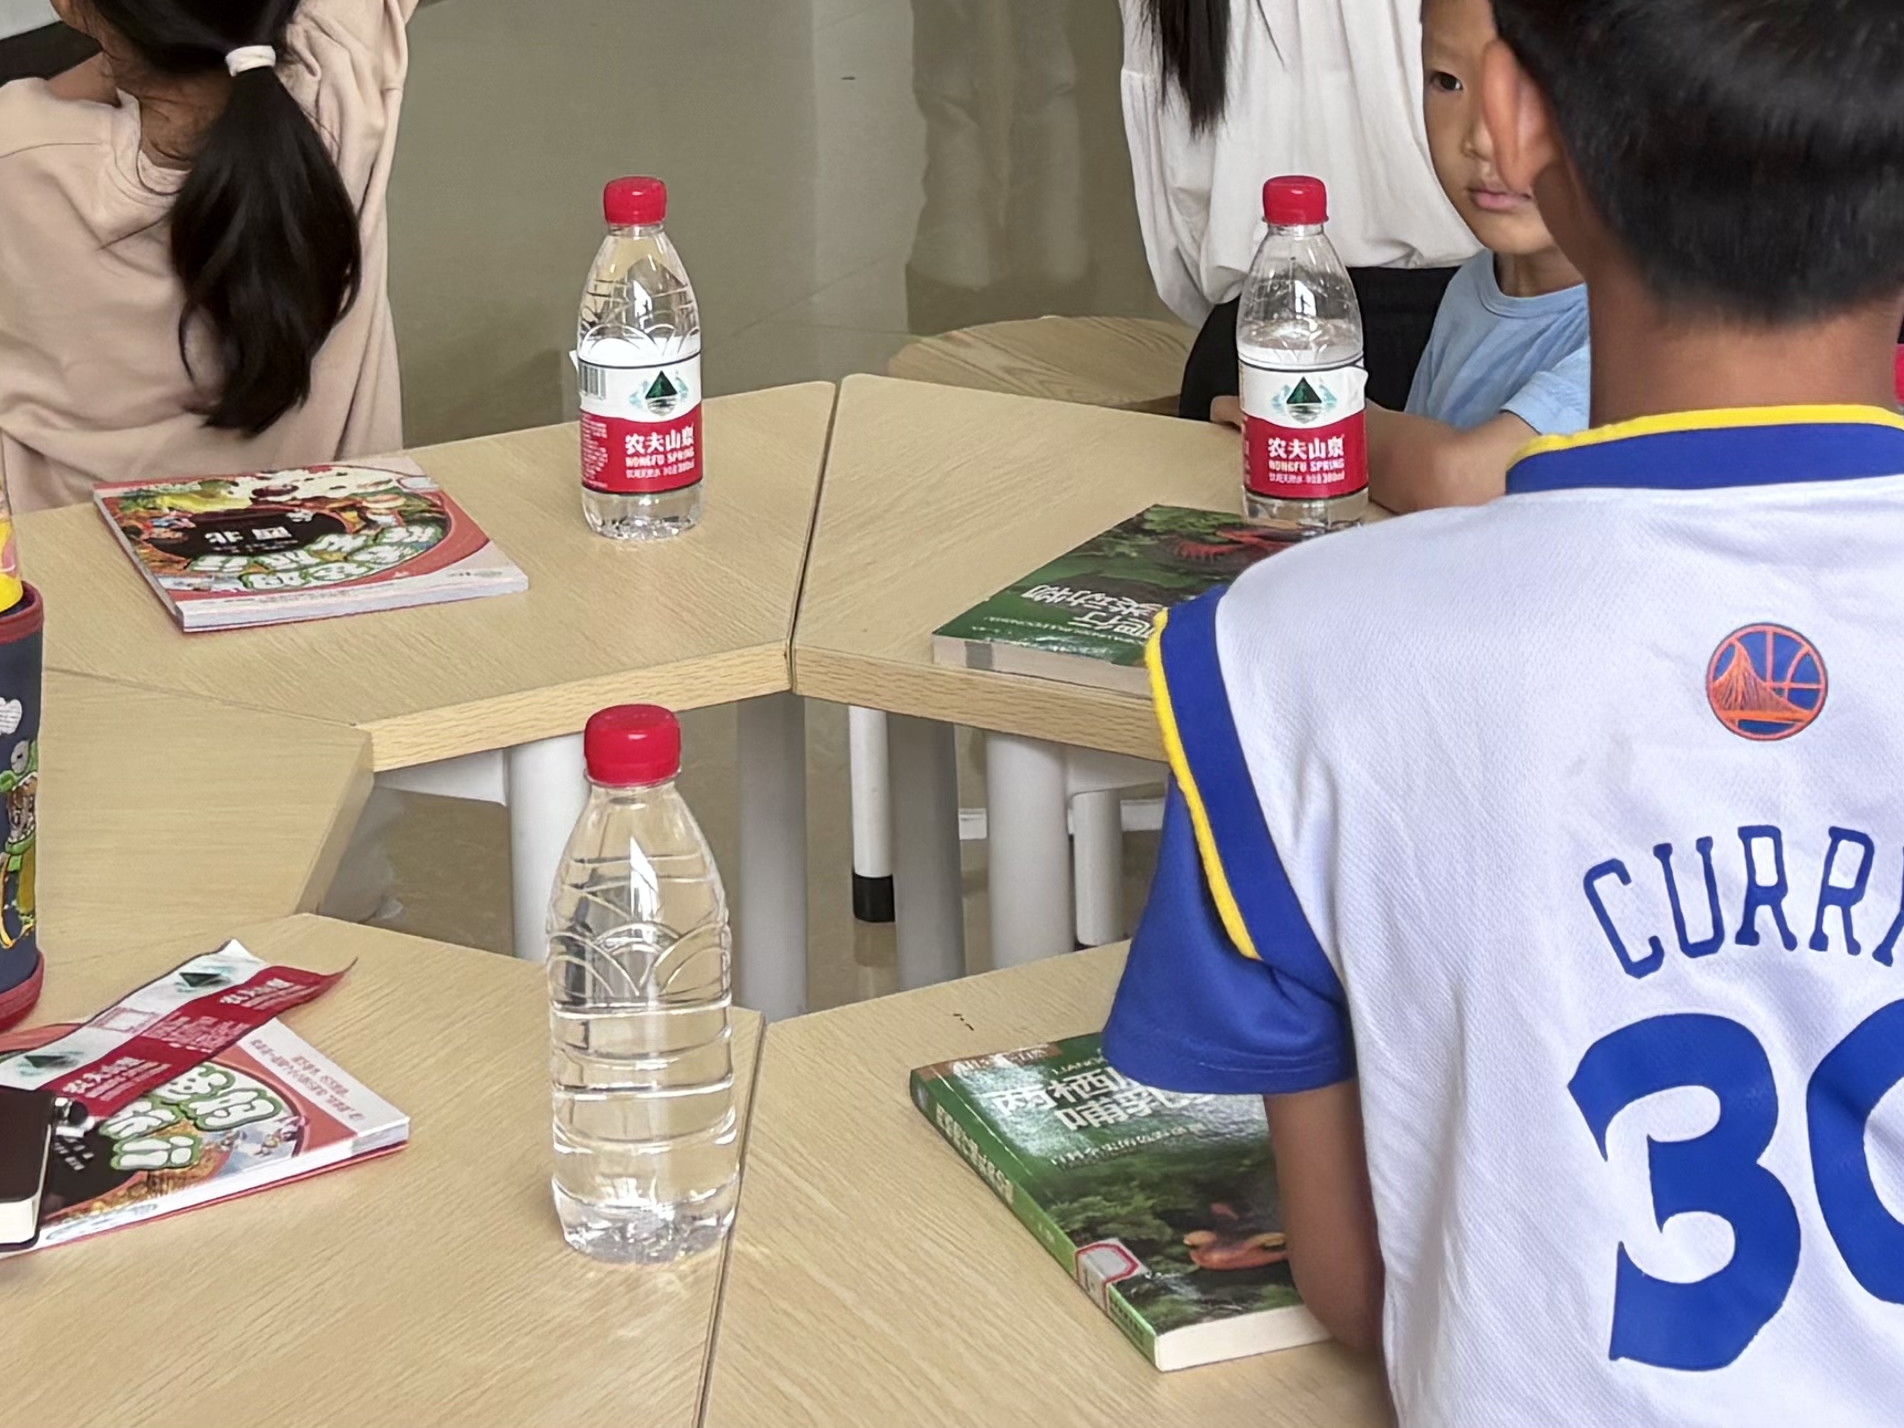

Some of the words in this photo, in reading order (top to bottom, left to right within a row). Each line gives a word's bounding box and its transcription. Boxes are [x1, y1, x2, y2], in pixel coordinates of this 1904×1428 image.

[625, 423, 694, 455] 农夫山泉
[1267, 434, 1345, 460] 农夫山泉
